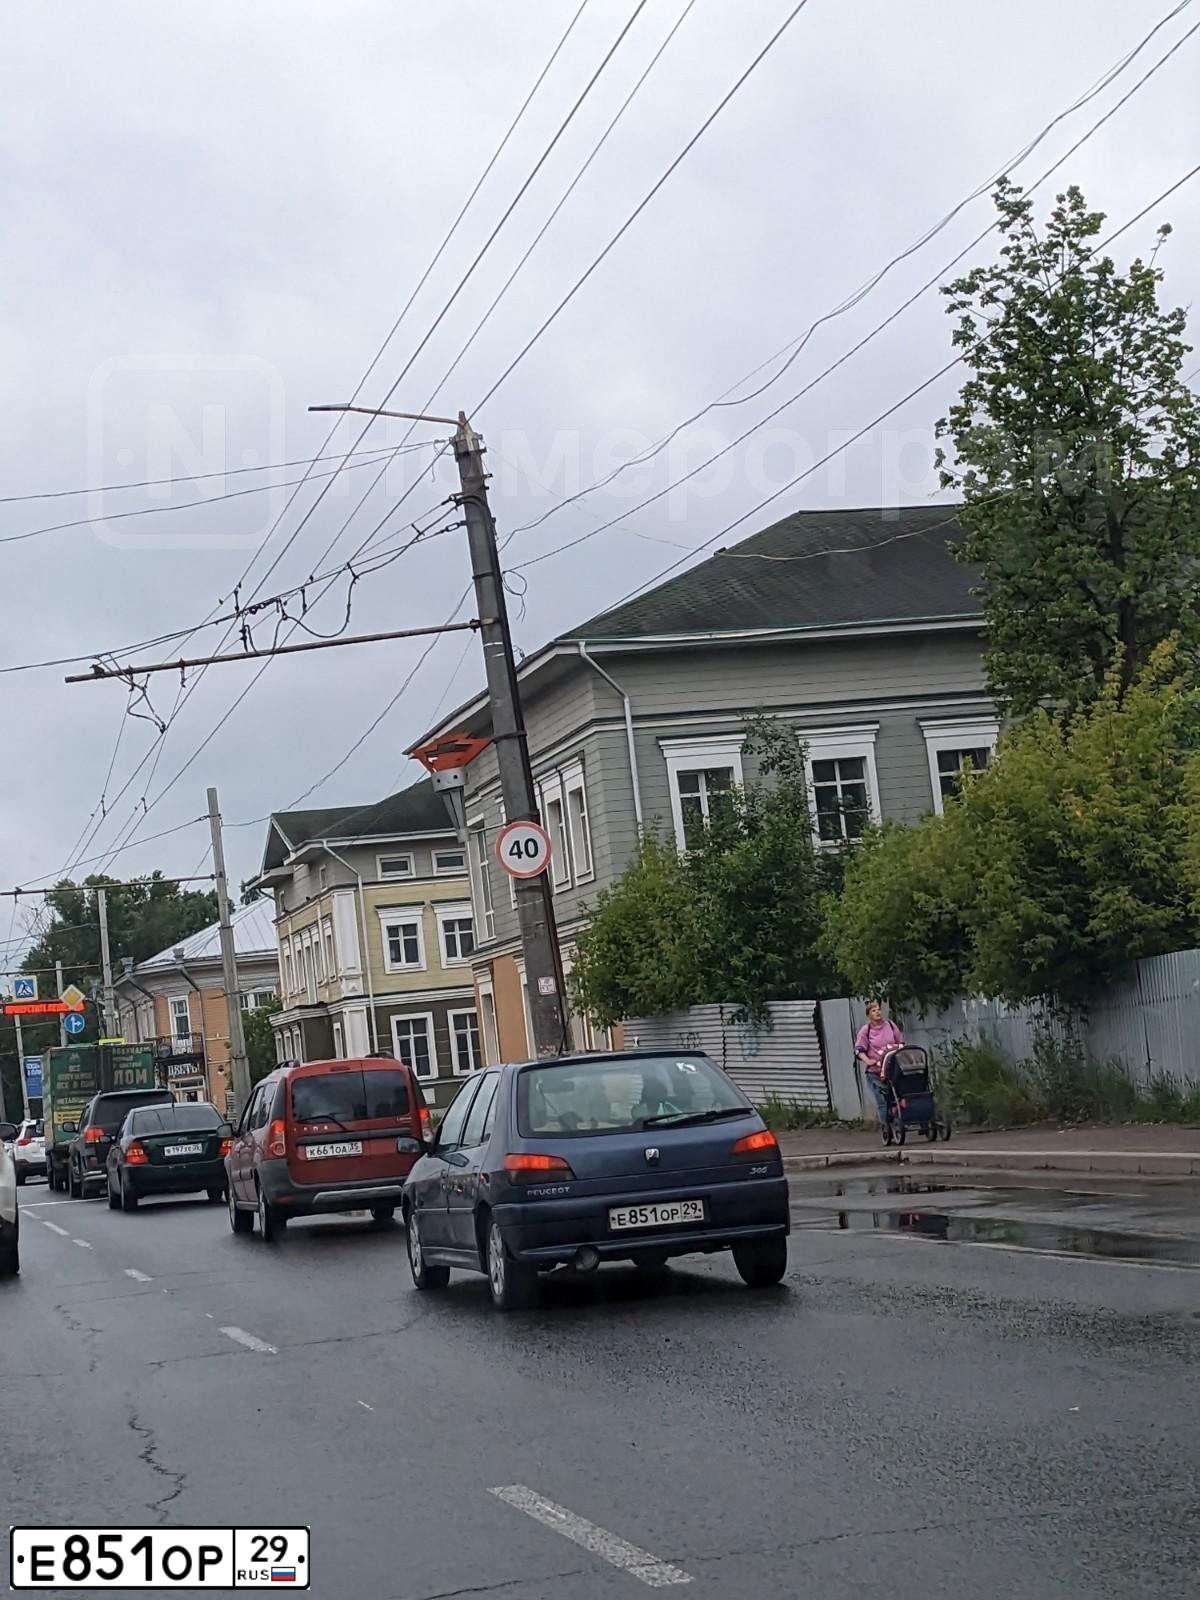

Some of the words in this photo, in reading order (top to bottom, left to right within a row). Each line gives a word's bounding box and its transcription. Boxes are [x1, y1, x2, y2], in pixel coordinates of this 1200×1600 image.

[509, 838, 538, 859] 40
[114, 1069, 147, 1085] ЛОМ
[527, 1186, 570, 1197] PEUGEOT
[617, 1207, 678, 1226] Е851ОР
[682, 1202, 698, 1215] 29
